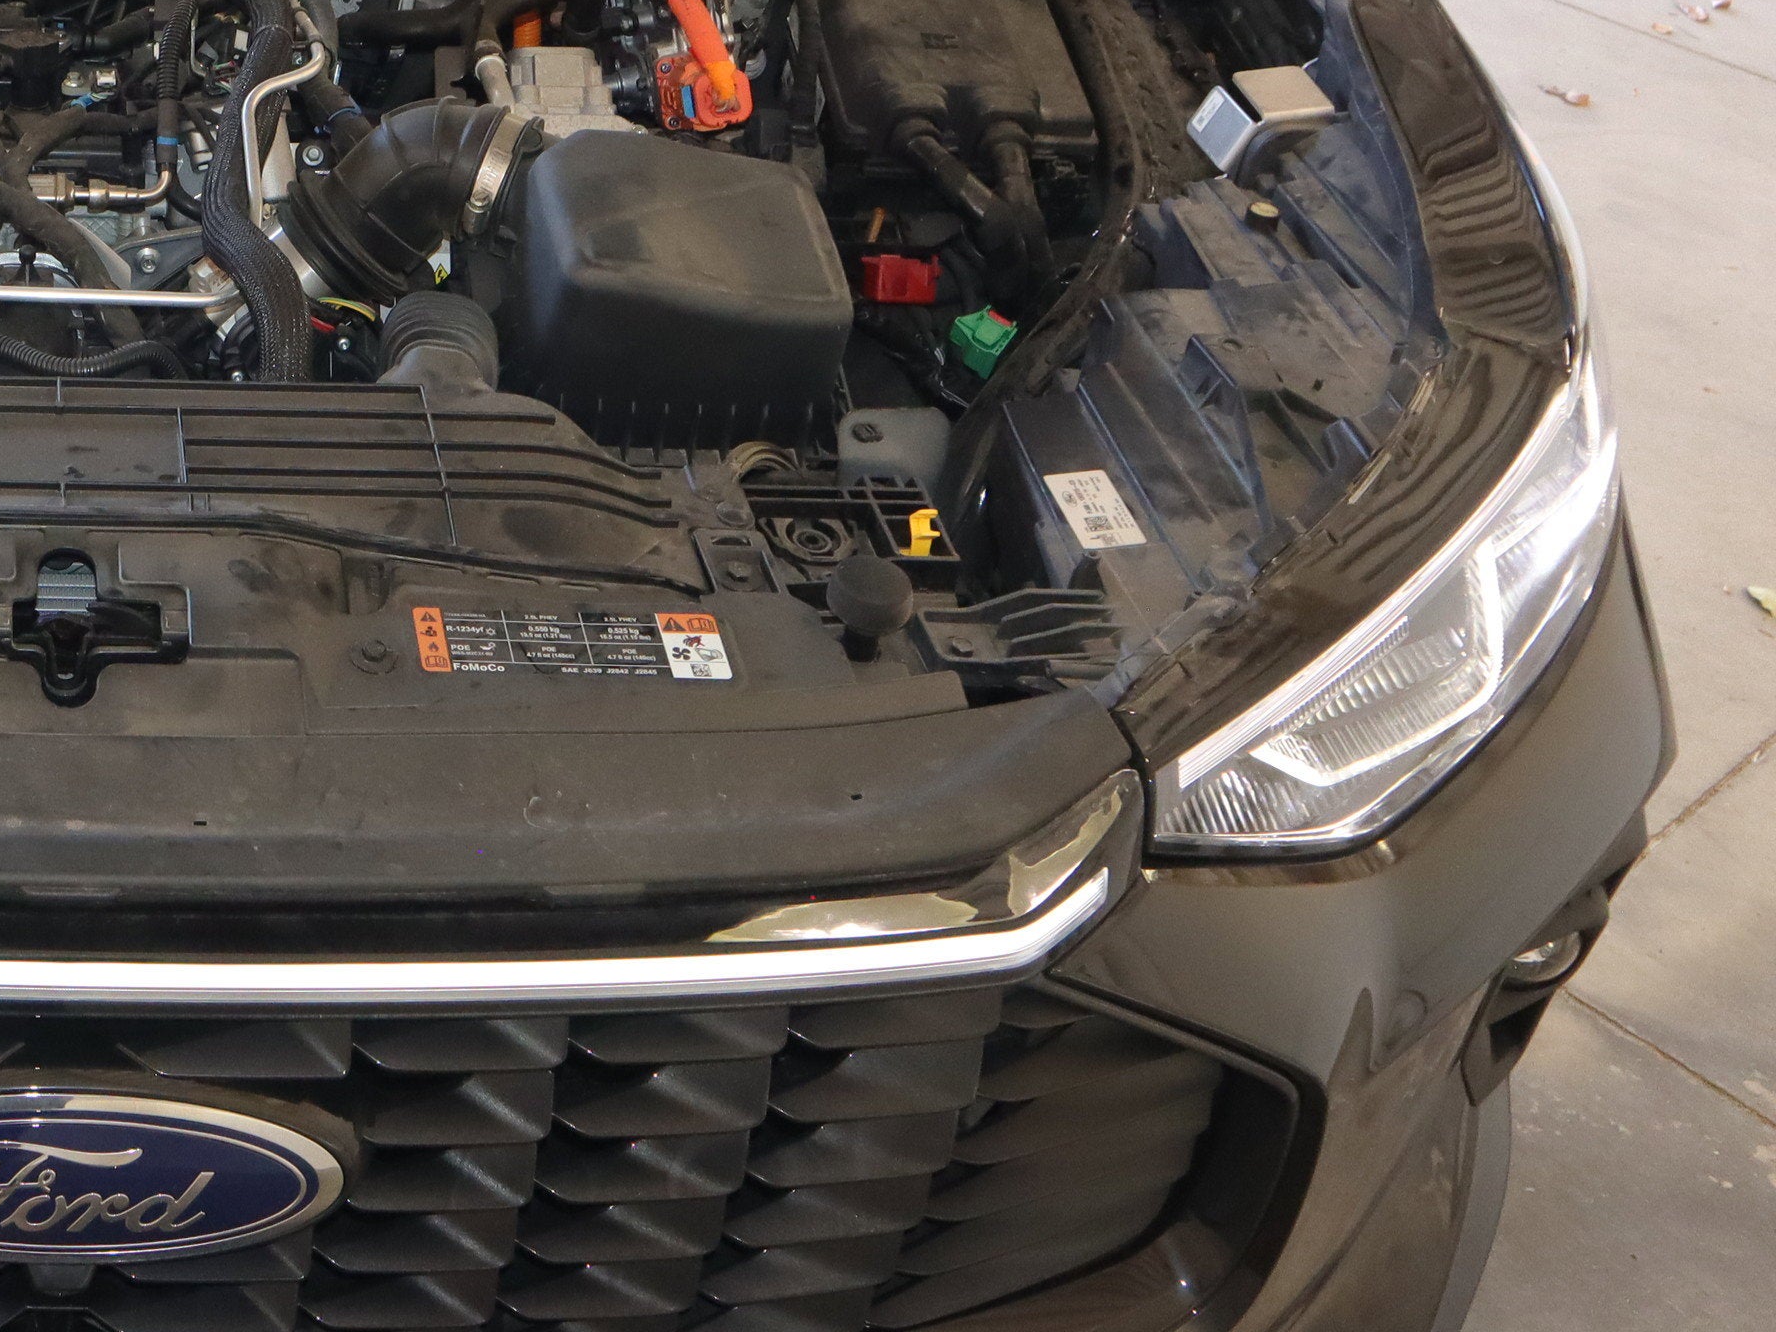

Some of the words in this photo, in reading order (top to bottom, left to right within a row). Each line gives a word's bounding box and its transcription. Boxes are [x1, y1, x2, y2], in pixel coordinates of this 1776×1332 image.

[446, 625, 484, 634] R-1234yf
[549, 626, 560, 634] kg
[628, 628, 640, 636] kg
[453, 663, 505, 672] FoMoCo
